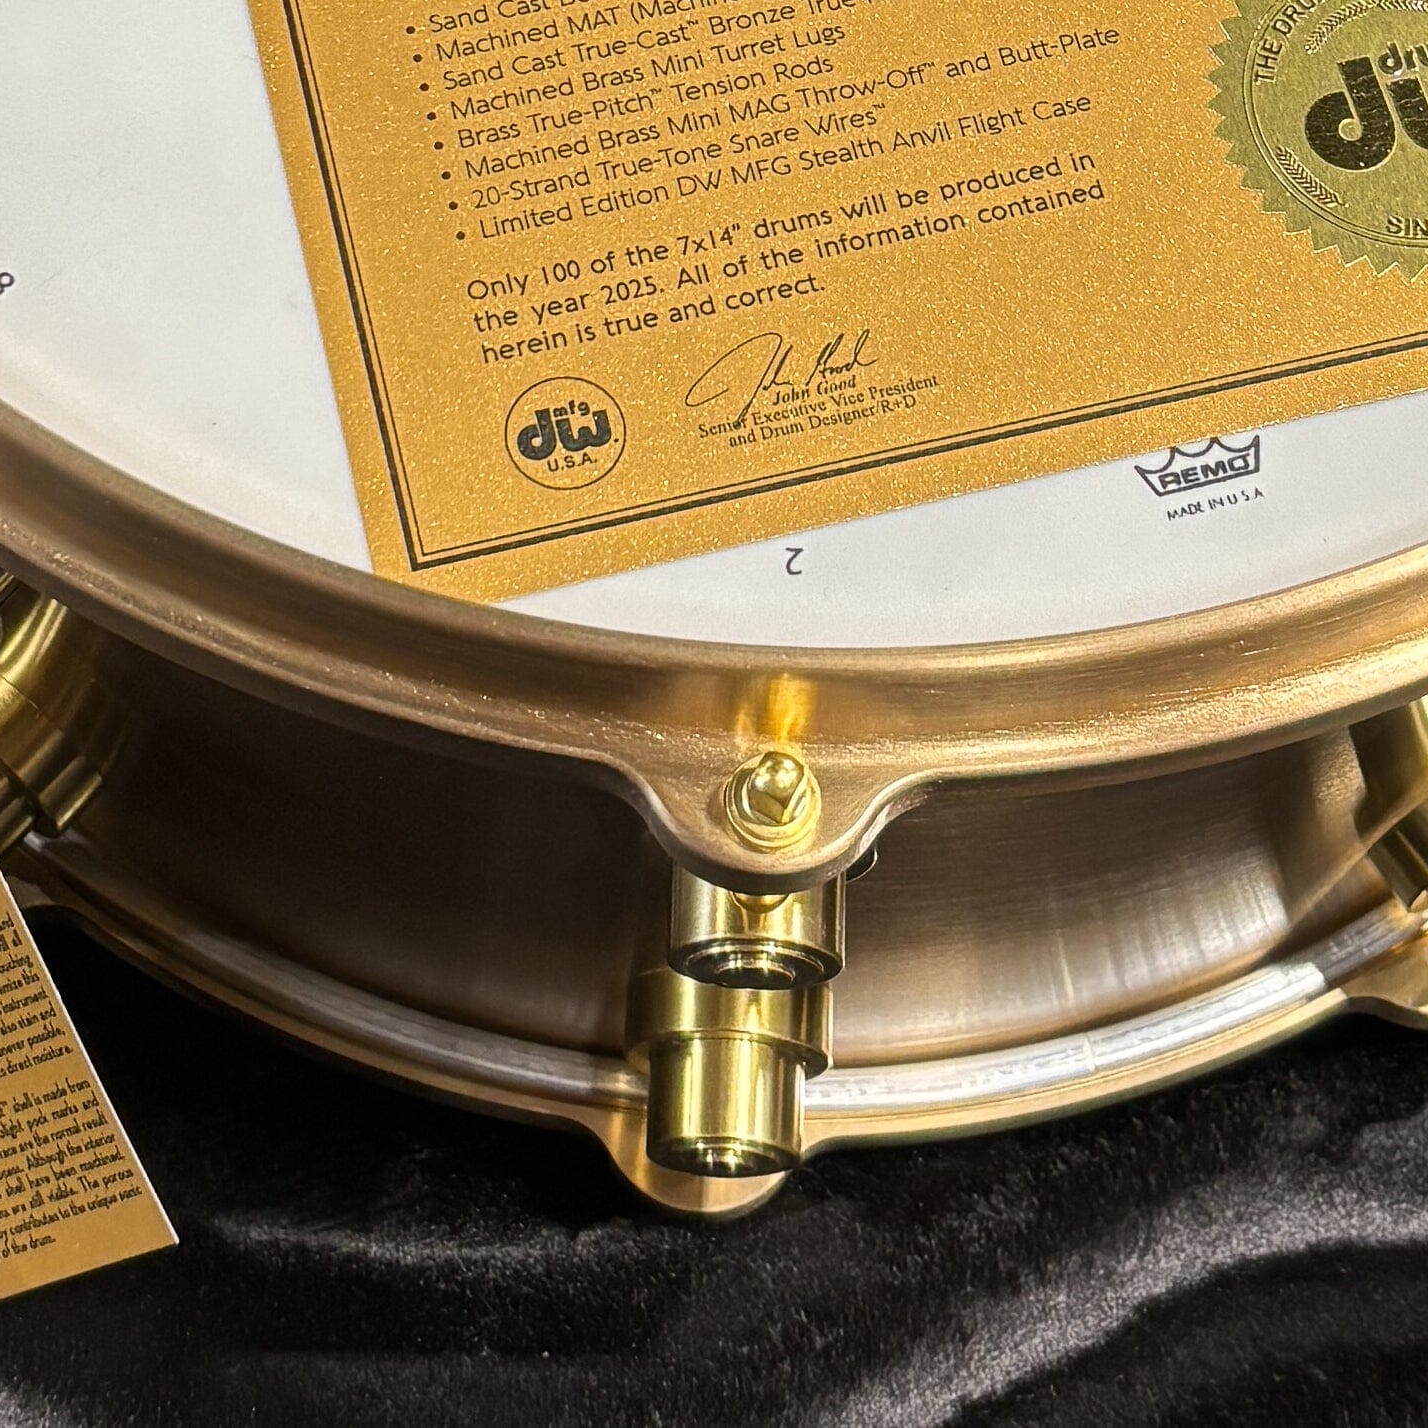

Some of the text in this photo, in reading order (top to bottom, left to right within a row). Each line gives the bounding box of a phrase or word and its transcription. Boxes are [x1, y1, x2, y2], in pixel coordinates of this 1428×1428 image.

[428, 3, 489, 33] Sand
[434, 18, 559, 62] Machined
[565, 4, 620, 35] MAT
[442, 59, 504, 90] Sand
[510, 47, 567, 75] Cast
[707, 5, 795, 35] Bronze
[449, 25, 846, 120] Machined Brass Mini Turret Lugs
[1255, 36, 1283, 85] THE
[456, 122, 521, 148] Brass
[669, 71, 766, 103] Tension
[772, 54, 834, 82] Rods
[464, 134, 590, 179] Machined
[597, 124, 661, 151] Brass
[666, 106, 721, 135] Mini
[727, 92, 791, 123] MAG
[944, 50, 991, 78] and
[997, 27, 1120, 66] Butt-Plate
[470, 165, 591, 209] 20-Strand
[594, 142, 722, 181] True-Tone
[728, 126, 799, 154] Snare
[478, 96, 1091, 239] Limited Edition DW MFG Stealth Anvil Flight Case
[466, 272, 529, 300] Only
[540, 258, 581, 285] 100
[589, 249, 615, 274] of
[623, 244, 669, 266] the
[752, 209, 833, 239] drums
[838, 192, 887, 220] will
[894, 188, 929, 209] be
[938, 155, 1062, 201] produced
[1068, 152, 1096, 172] in
[472, 178, 1105, 332] the year 2025. All of the information contained
[480, 272, 825, 364] herein is true and correct.
[750, 400, 827, 426] Executive
[828, 392, 864, 407] Vice
[867, 375, 939, 400] President
[772, 387, 811, 406] John
[546, 451, 598, 473] U.S.A.
[728, 428, 757, 448] and
[760, 420, 805, 441] Drum
[1157, 452, 1252, 490] REMO
[1166, 500, 1206, 522] MADE
[784, 546, 804, 576] 2
